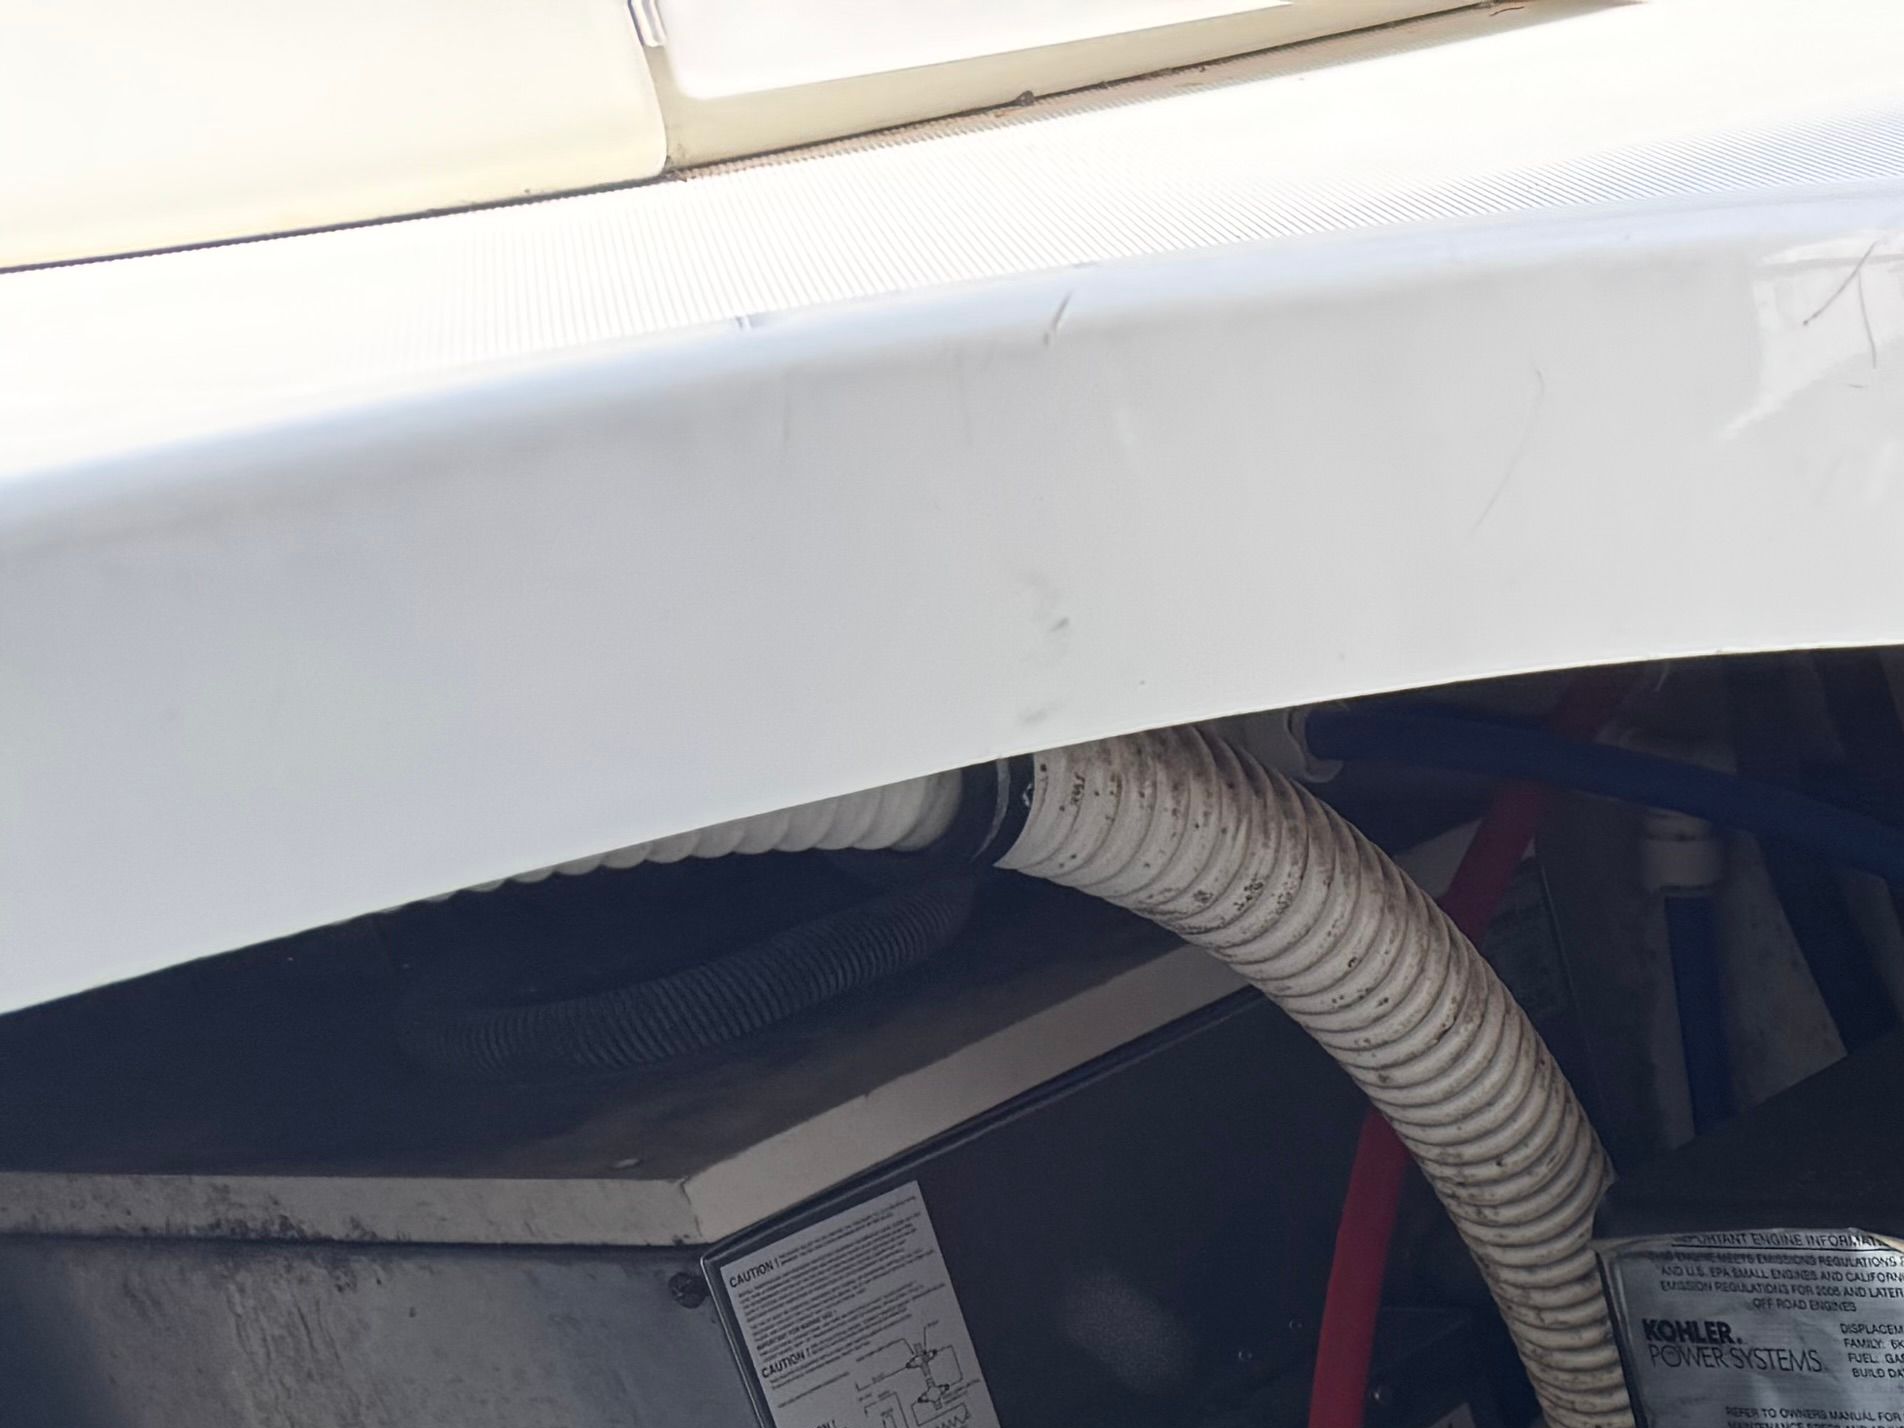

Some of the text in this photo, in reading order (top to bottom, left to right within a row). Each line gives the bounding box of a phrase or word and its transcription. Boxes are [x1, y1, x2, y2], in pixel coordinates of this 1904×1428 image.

[730, 1260, 775, 1288] CAUTION
[1639, 1317, 1739, 1345] KOHLER
[762, 1352, 806, 1378] CAUTION
[1646, 1341, 1824, 1373] POWER SYSTEMS
